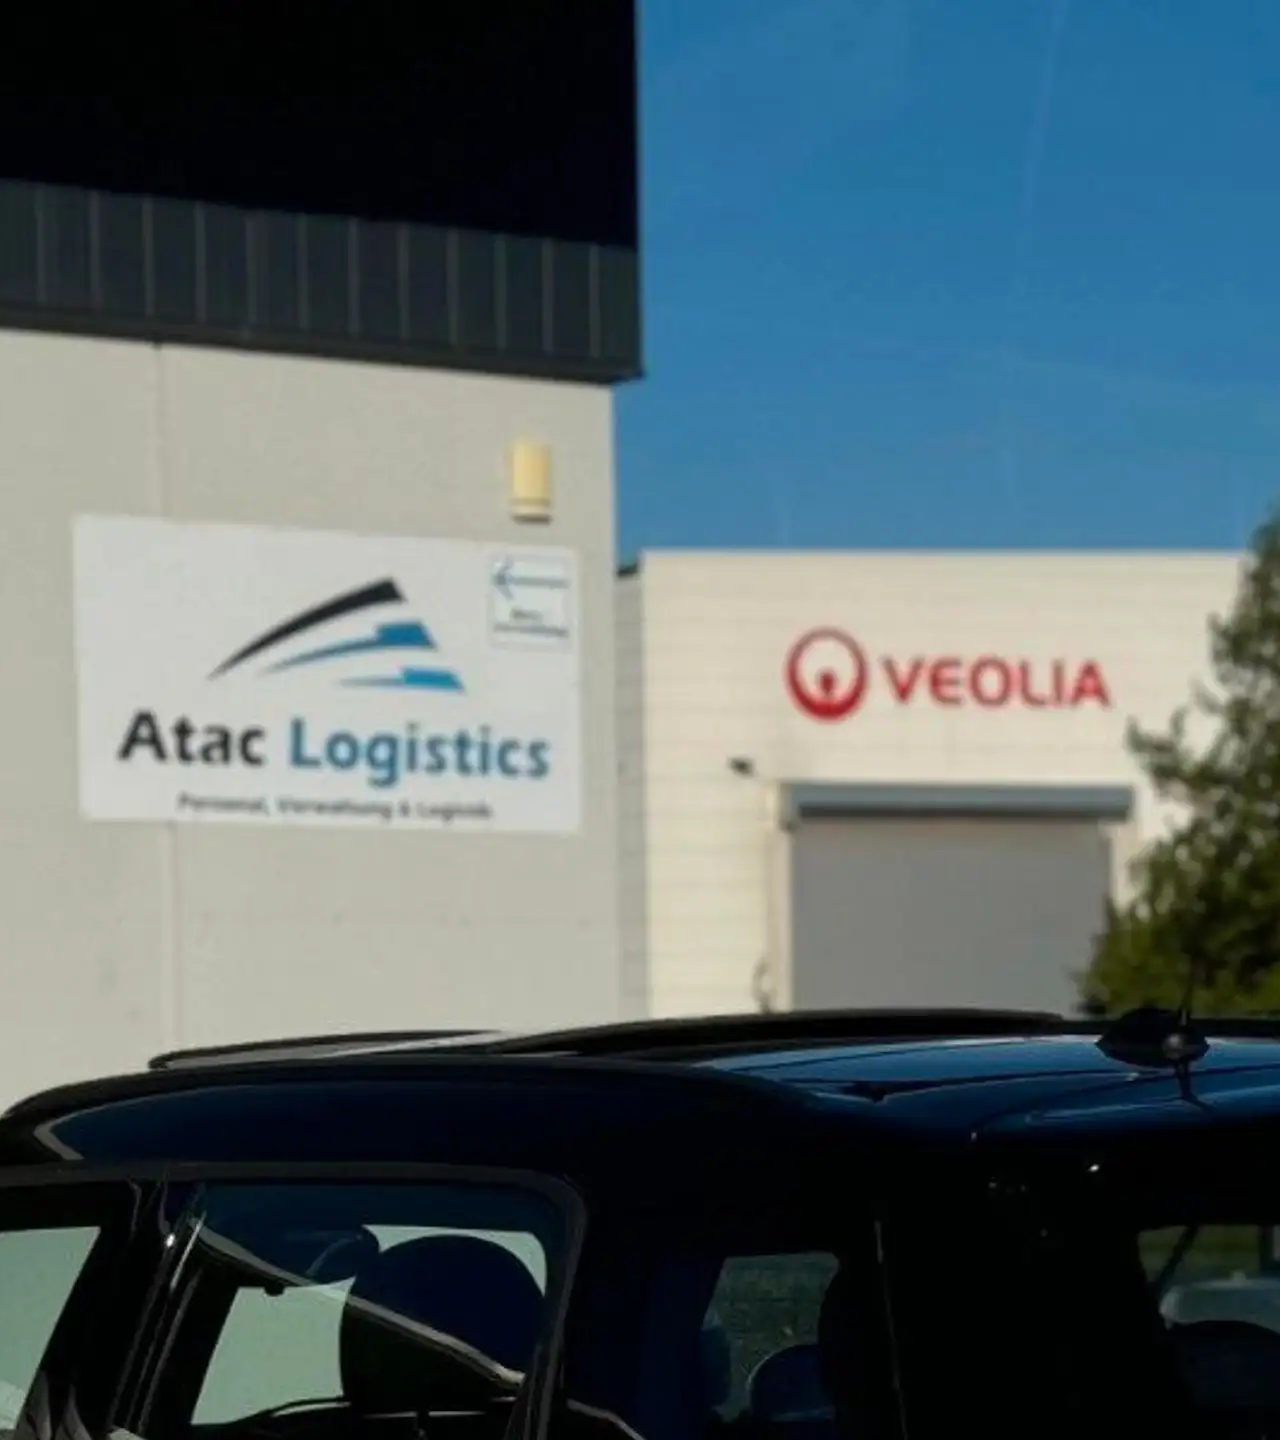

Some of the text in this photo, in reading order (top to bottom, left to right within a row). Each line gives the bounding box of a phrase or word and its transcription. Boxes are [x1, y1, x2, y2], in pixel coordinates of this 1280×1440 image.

[882, 654, 1111, 708] VEOLIA
[117, 709, 551, 788] Atac Logistics
